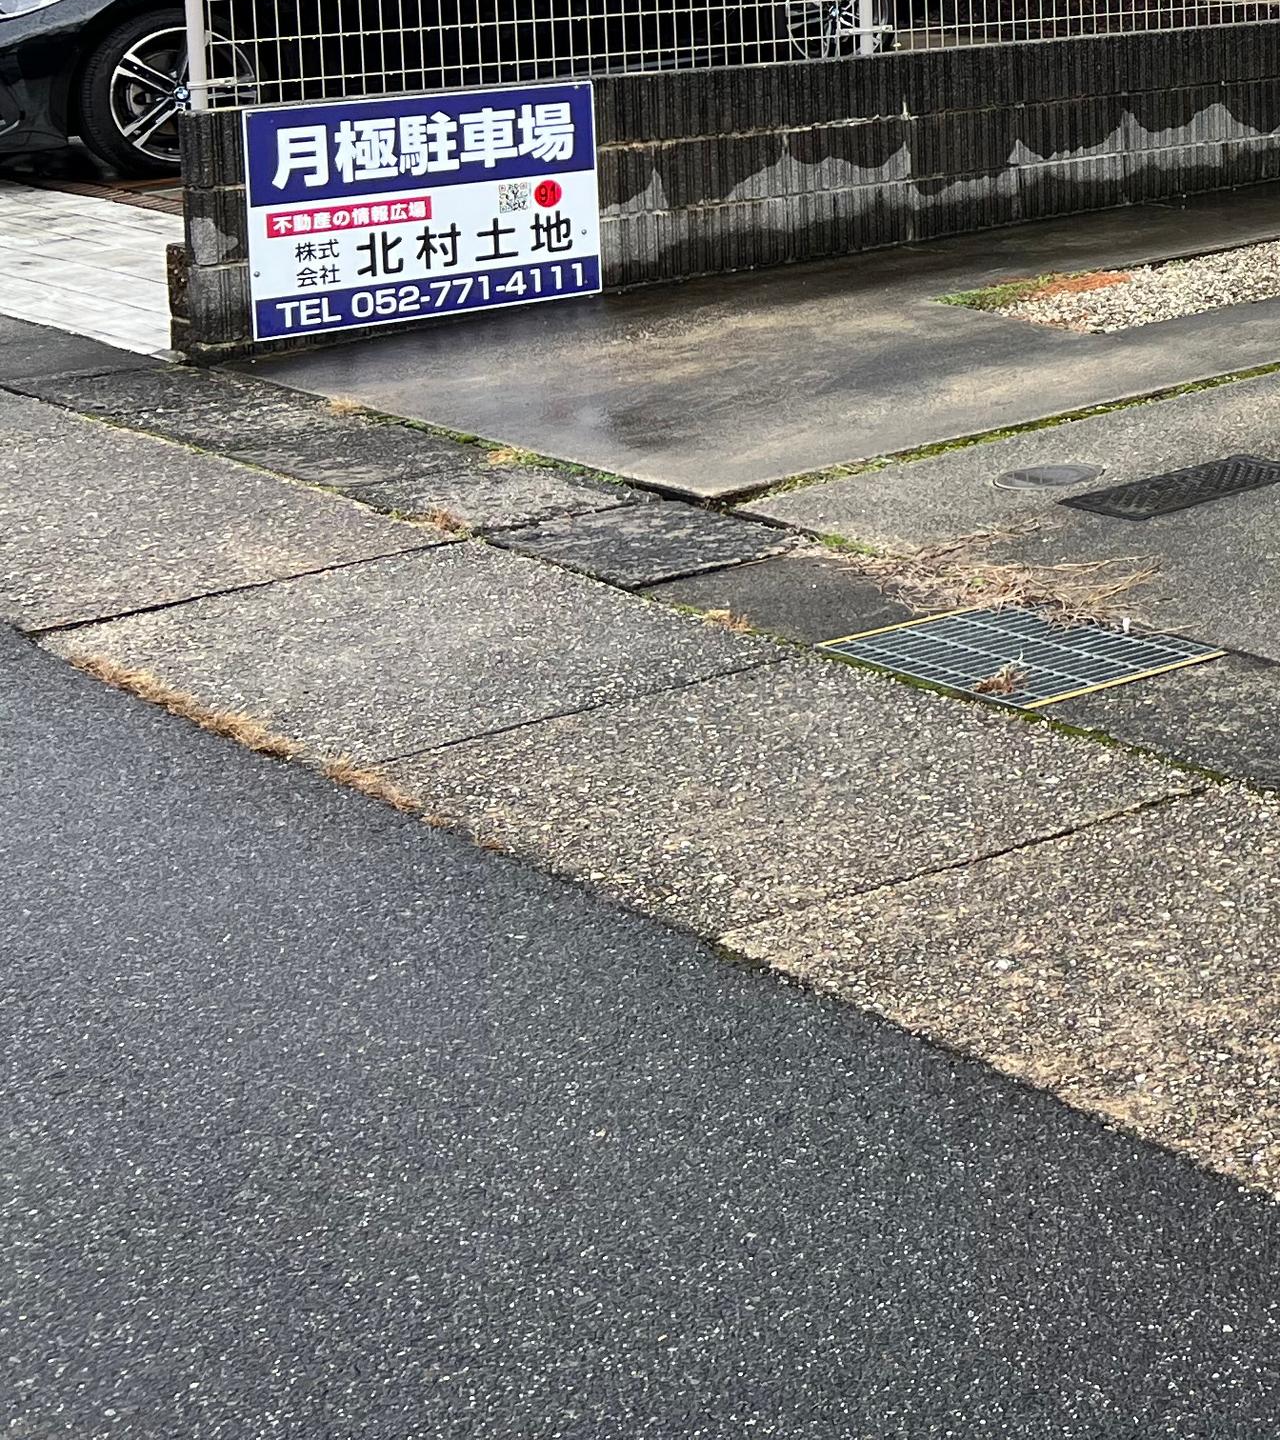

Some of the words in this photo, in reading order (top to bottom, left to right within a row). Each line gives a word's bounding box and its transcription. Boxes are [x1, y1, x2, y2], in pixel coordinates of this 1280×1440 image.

[272, 102, 575, 191] 月極駐車場
[273, 206, 427, 234] 不動産の情報広場
[356, 210, 573, 277] 北村土地
[295, 238, 340, 262] 株式
[276, 301, 342, 329] TEL
[351, 262, 585, 319] 052-771-4111
[296, 264, 342, 288] 会社
